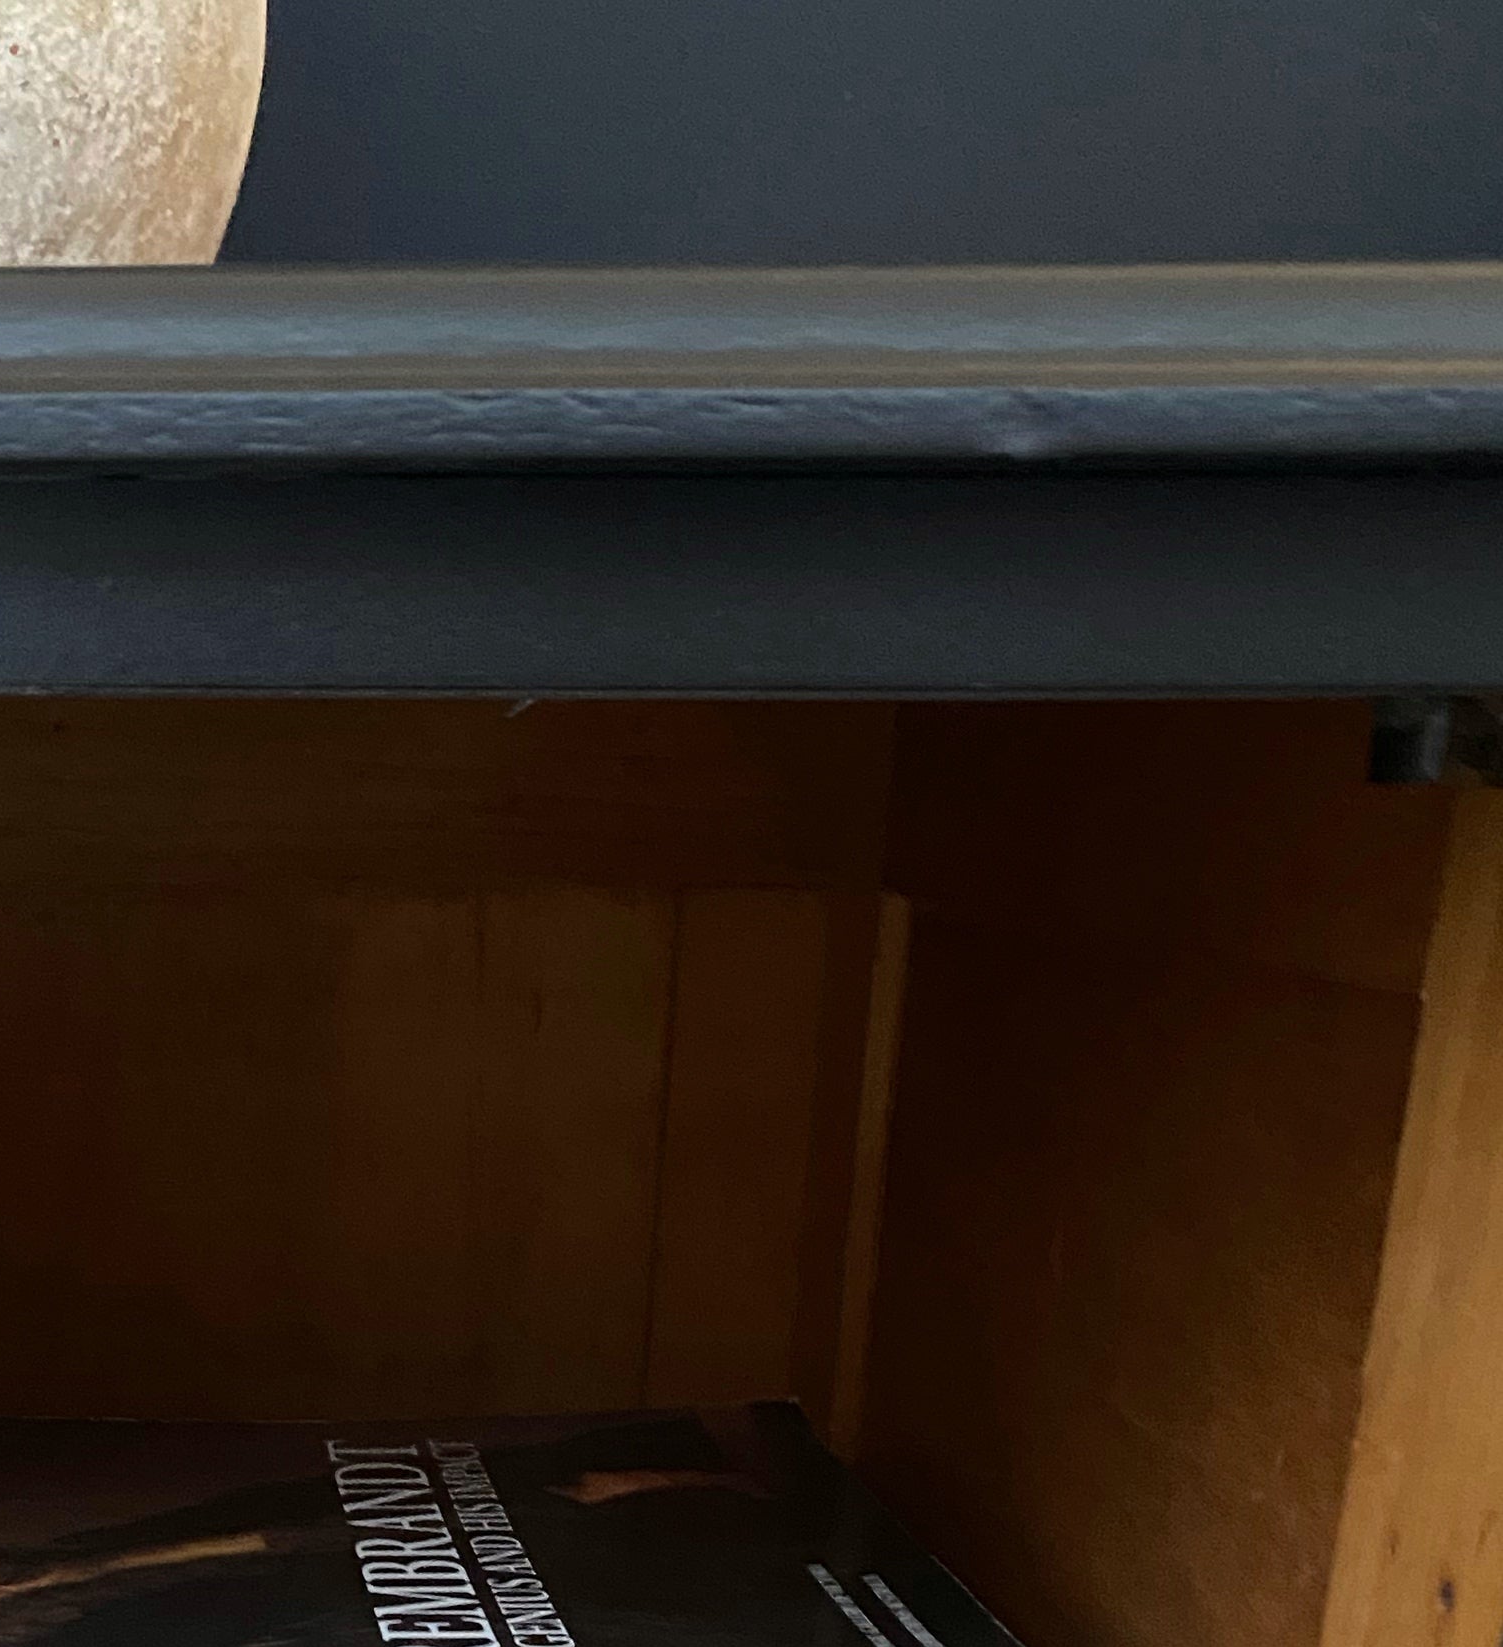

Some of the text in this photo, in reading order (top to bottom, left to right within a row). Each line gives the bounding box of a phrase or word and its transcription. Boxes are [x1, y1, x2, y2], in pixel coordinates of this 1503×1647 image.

[428, 1438, 499, 1502] IMPACT
[453, 1502, 514, 1533] HIS
[469, 1535, 537, 1576] AND
